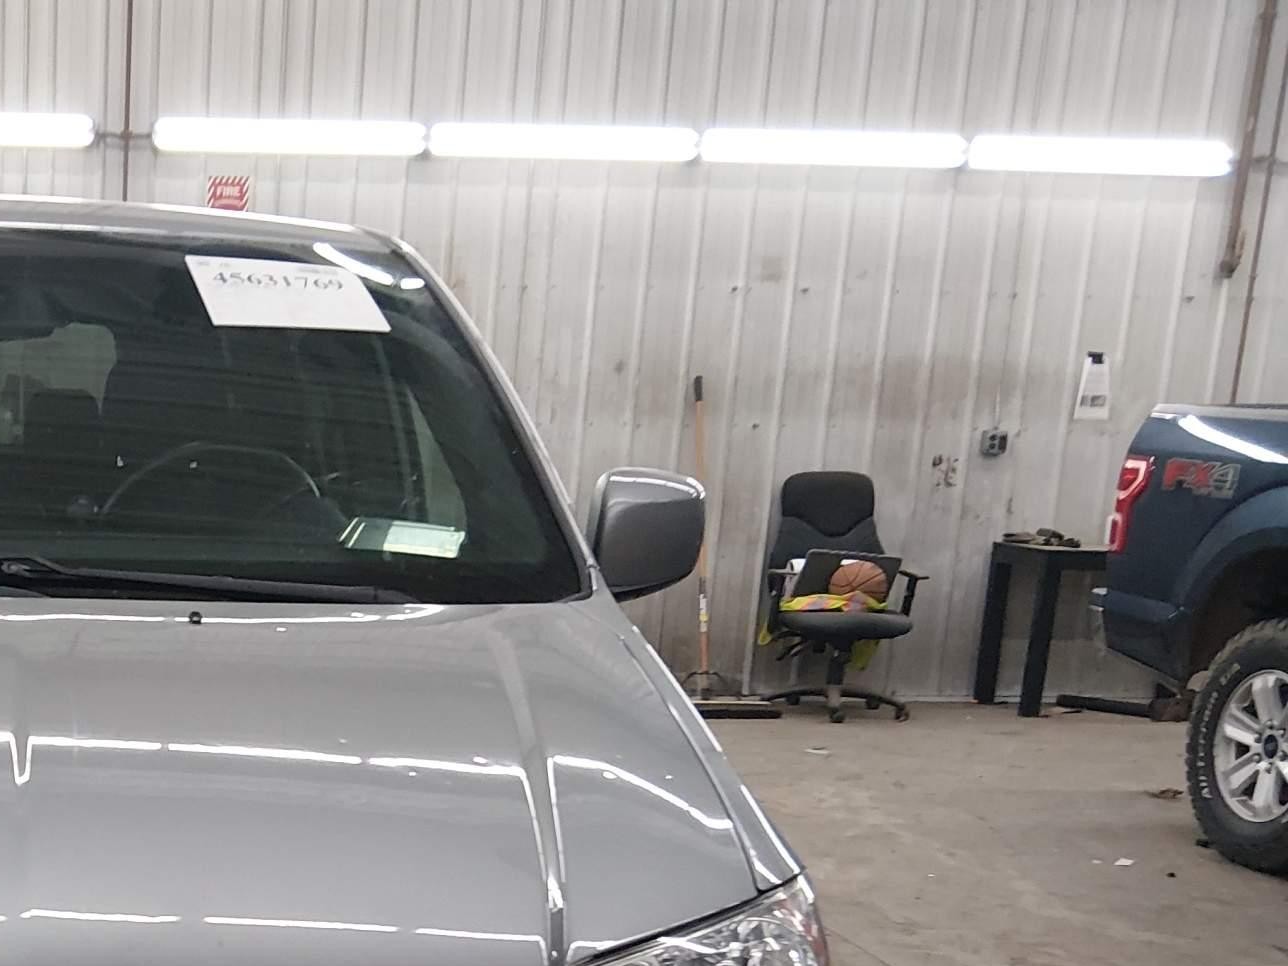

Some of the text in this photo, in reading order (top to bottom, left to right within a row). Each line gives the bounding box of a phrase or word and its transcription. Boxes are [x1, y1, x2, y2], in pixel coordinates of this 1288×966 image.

[215, 184, 242, 198] FIRE
[212, 271, 344, 291] 45631769
[1161, 457, 1241, 492] FX4
